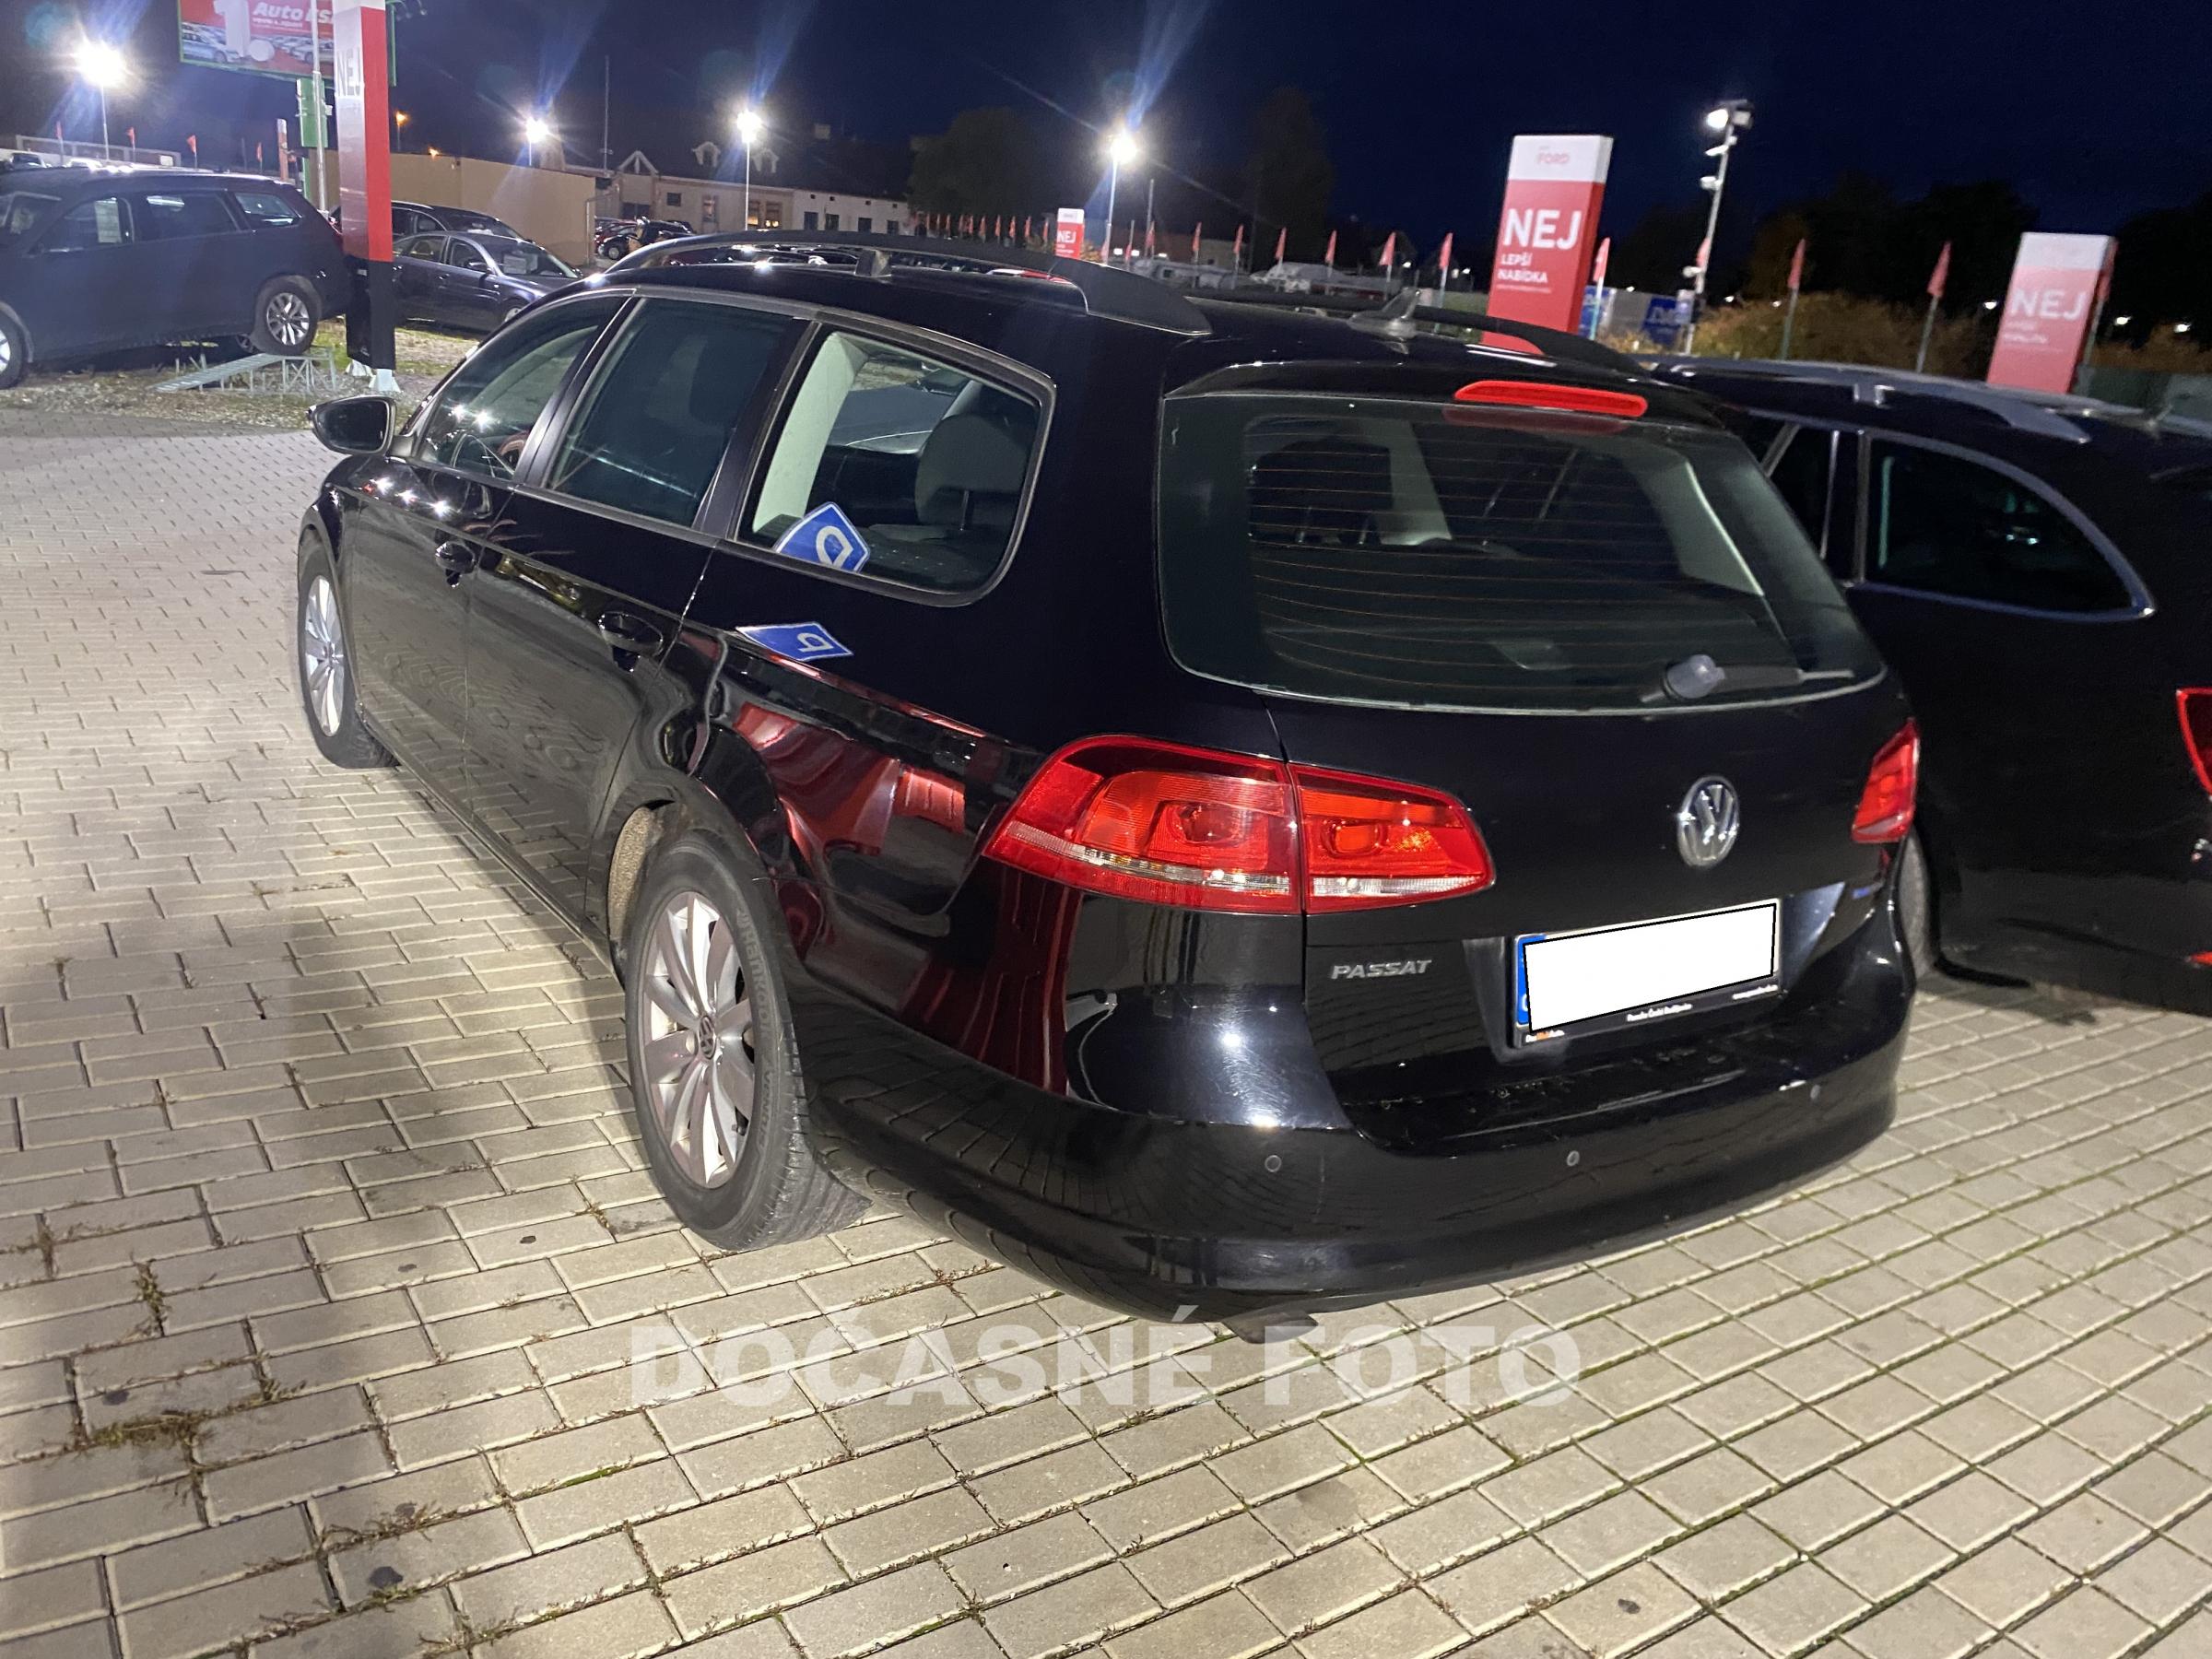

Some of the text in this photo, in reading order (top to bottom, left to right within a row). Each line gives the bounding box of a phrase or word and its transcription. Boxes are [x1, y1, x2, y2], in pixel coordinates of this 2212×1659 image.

[253, 3, 304, 21] Auto
[336, 47, 361, 97] NEJ
[1537, 153, 1571, 165] FORD
[1056, 229, 1077, 243] NEJ
[1503, 208, 1583, 250] NEJ
[2010, 288, 2088, 321] NEJ
[1331, 959, 1432, 979] PASSAT
